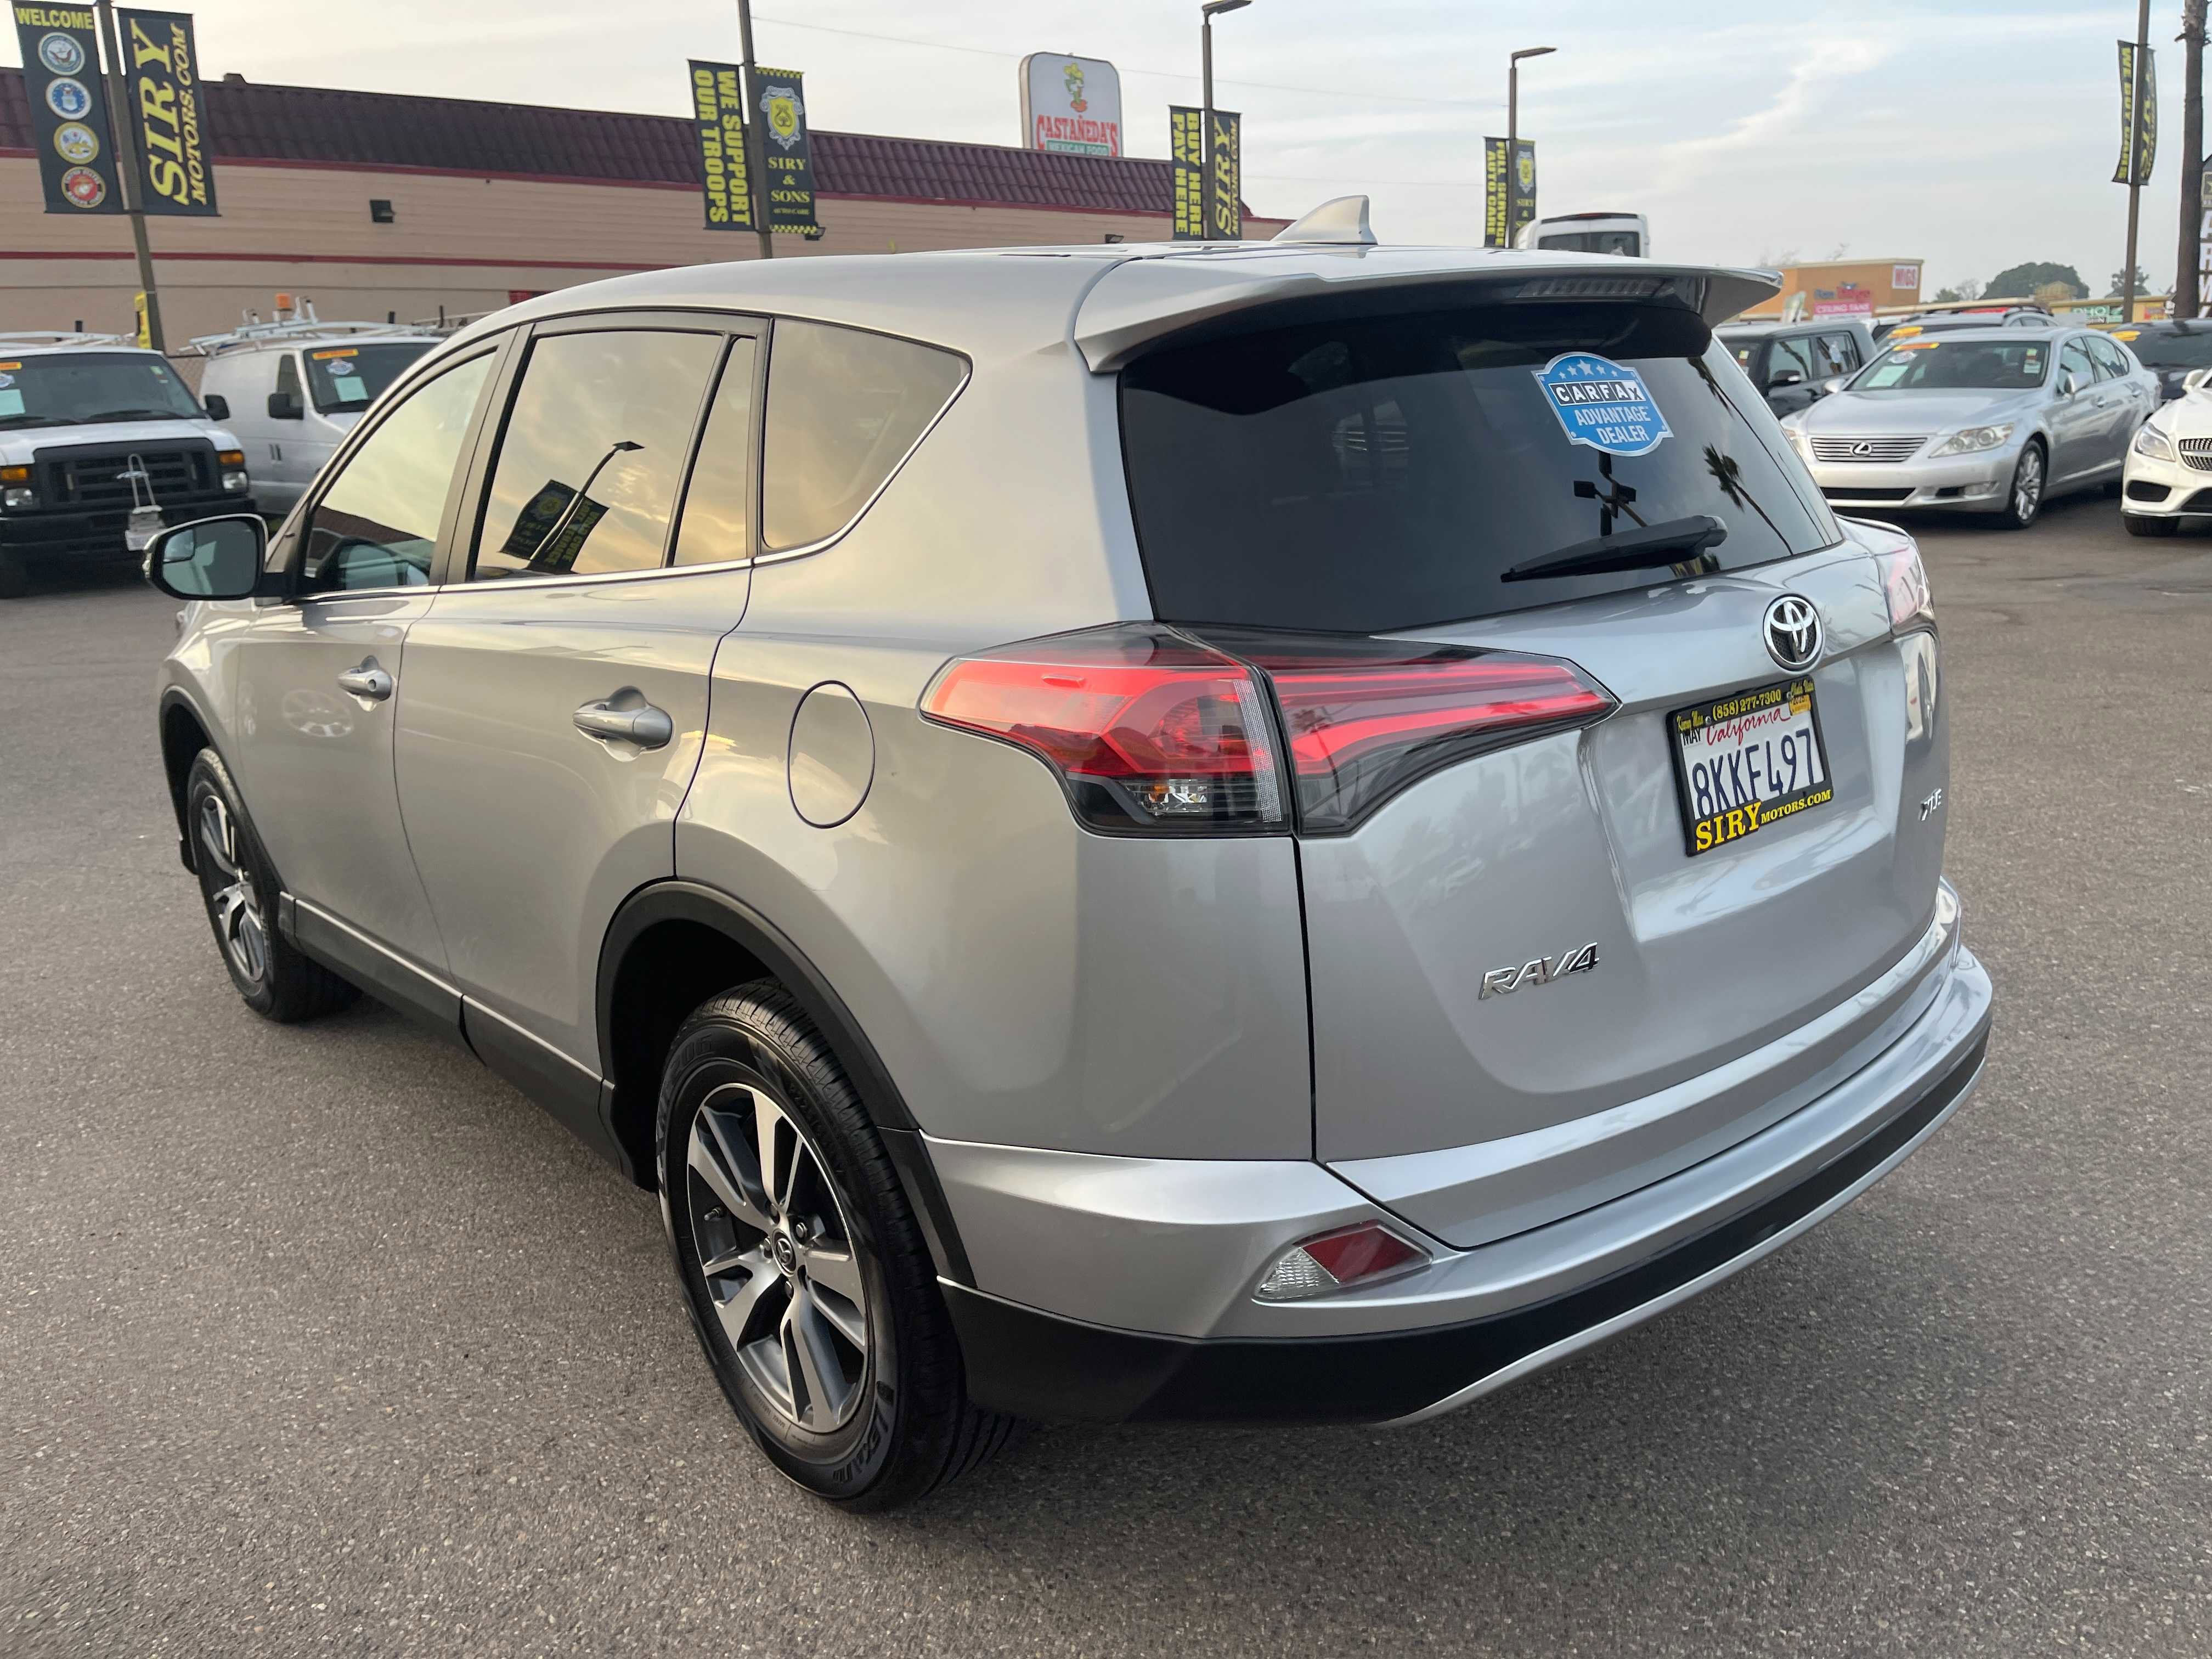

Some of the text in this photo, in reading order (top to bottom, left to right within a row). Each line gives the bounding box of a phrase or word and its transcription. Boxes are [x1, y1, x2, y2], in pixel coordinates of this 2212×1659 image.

[15, 8, 94, 30] WELCOME
[129, 18, 190, 206] SIRY
[170, 22, 207, 206] MOTORS.COM
[694, 70, 729, 223] OUR TROOPS
[716, 71, 751, 225] WE SUPPORT
[768, 157, 806, 171] SIRY
[1172, 114, 1188, 233] PAY HERE
[1186, 112, 1202, 236] BUY HERE
[1214, 116, 1231, 235] SIRY
[770, 189, 810, 203] SONS
[783, 174, 795, 185] &
[1486, 150, 1497, 235] AUTO CARE
[1495, 141, 1506, 246] FULL SERVICE
[1555, 384, 1643, 402] CARFAX
[1574, 406, 1651, 426] ADVANTAGE
[1596, 425, 1650, 444] DEALER
[1706, 707, 1791, 747] California
[1712, 689, 1782, 721] (858) 277-7300
[1683, 729, 1701, 746] MAY
[1692, 727, 1815, 817] 8KKF497
[1696, 789, 1832, 851] SIRY MOTORS.COM
[1478, 942, 1600, 1001] RAV4
